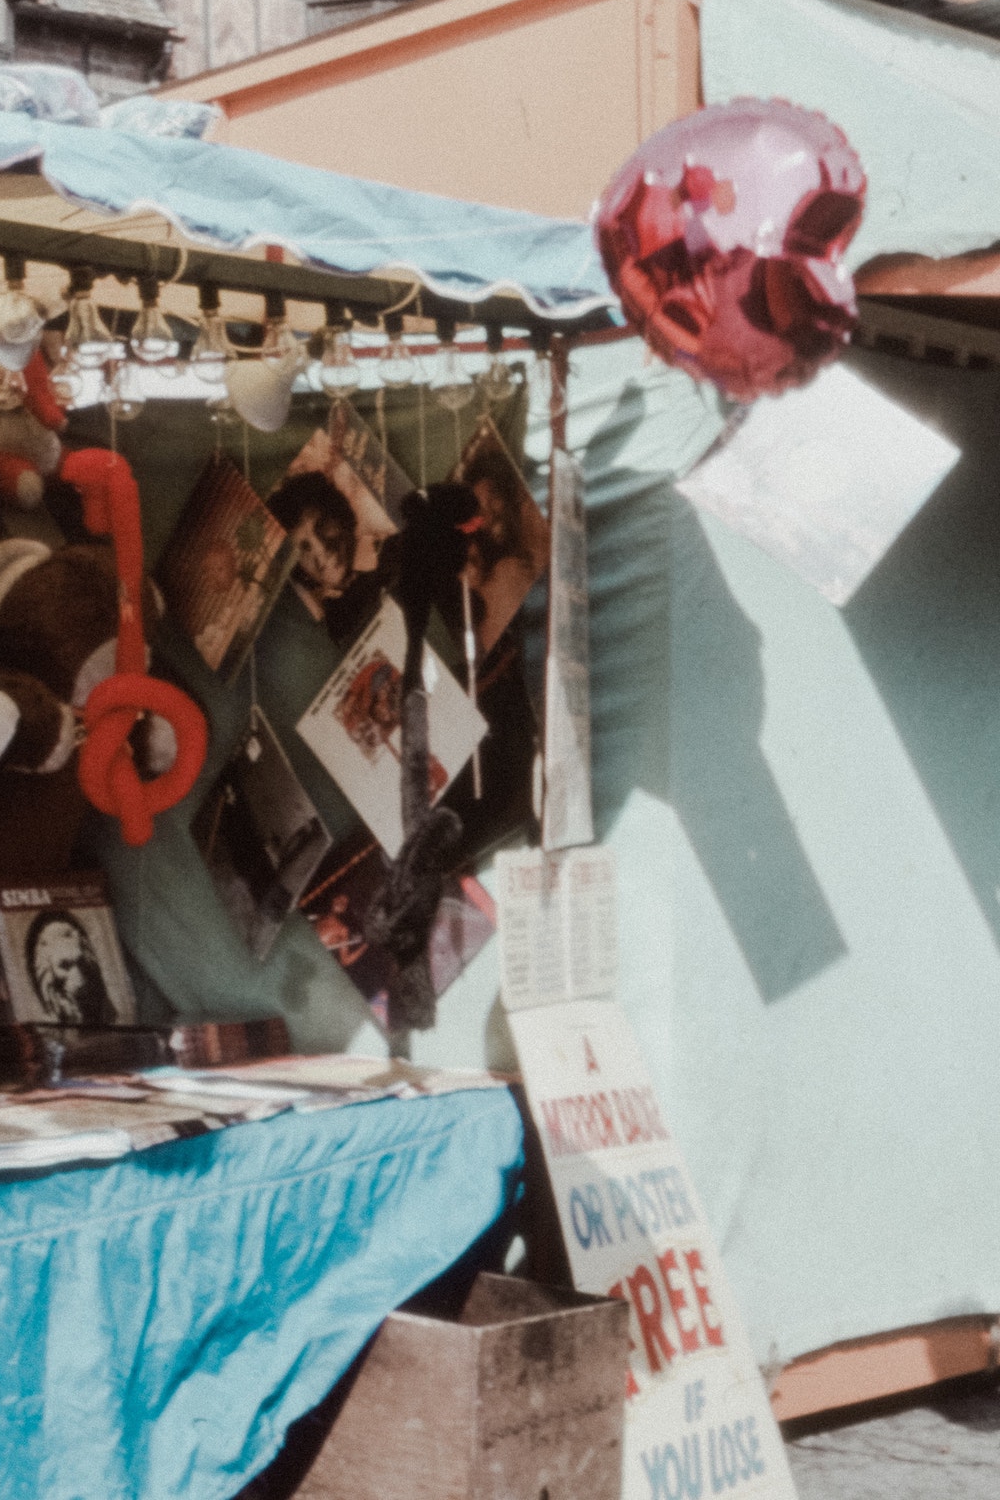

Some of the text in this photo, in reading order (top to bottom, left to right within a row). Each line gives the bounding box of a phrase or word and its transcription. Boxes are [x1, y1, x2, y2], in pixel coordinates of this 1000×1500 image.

[580, 1034, 599, 1075] A
[569, 1182, 613, 1251] OR
[684, 1379, 705, 1423] IF
[641, 1416, 766, 1500] YOU LOSE
